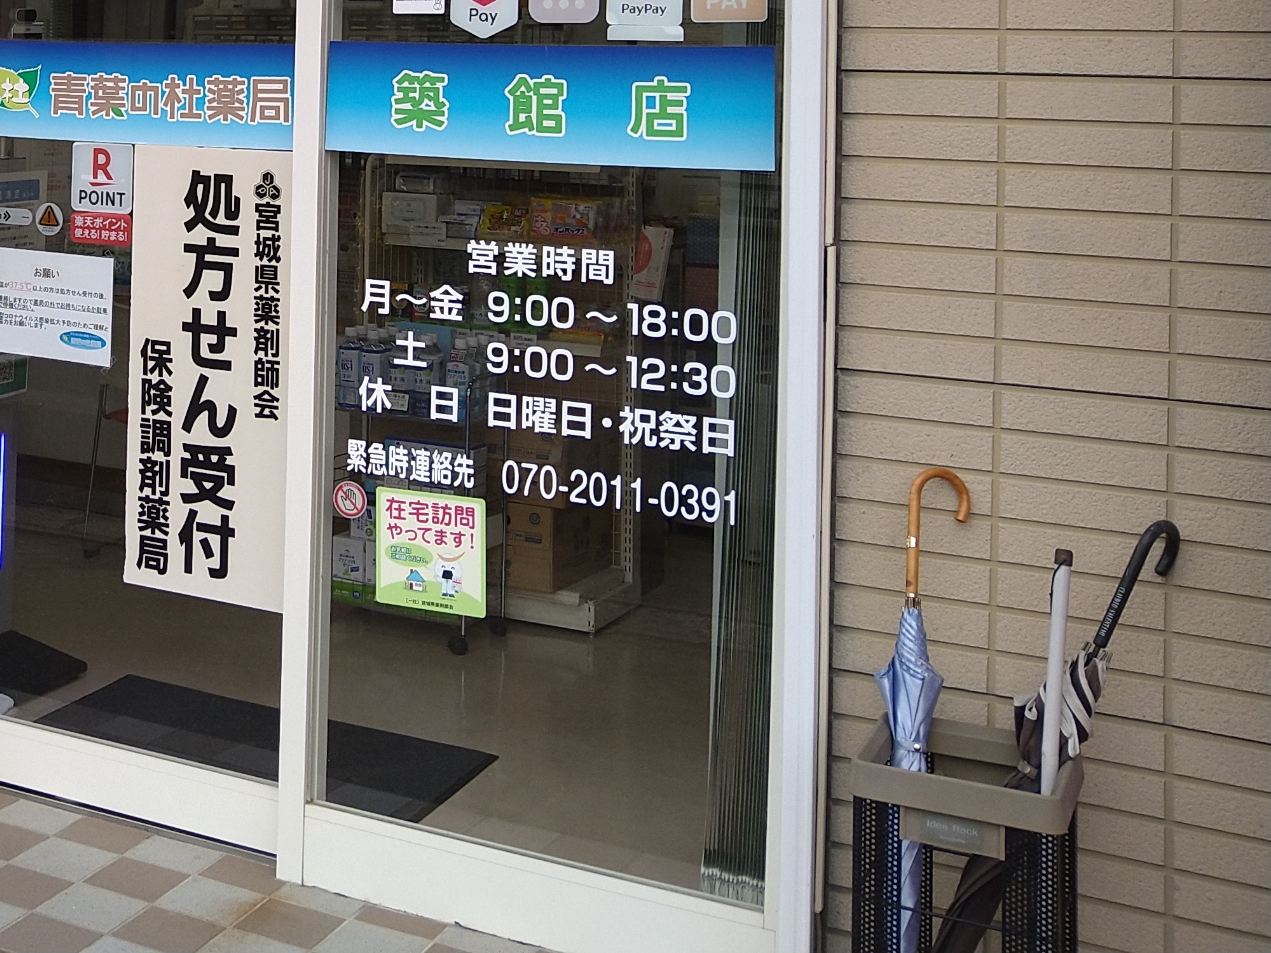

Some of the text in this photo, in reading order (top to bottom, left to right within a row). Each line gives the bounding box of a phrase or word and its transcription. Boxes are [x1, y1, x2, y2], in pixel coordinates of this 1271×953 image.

[469, 8, 498, 26] Pay
[621, 4, 667, 16] PayPay
[1, 77, 30, 103] 杜
[50, 73, 292, 126] 青葉の杜薬局
[391, 69, 691, 141] 築館店
[92, 148, 114, 180] R
[79, 190, 126, 207] POINT
[75, 216, 128, 230] 楽天ポイント
[33, 267, 60, 278] お願い
[466, 239, 616, 284] 営業時間
[253, 201, 282, 421] 宮城県薬剤師会
[360, 279, 464, 323] 月～金
[393, 331, 428, 370] 土
[178, 170, 240, 579] 処方せん受付
[487, 391, 736, 457] 日曜日・祝祭日
[136, 338, 173, 575] 保険調剤薬局
[346, 439, 737, 527] 緊急時連絡先 070-2011-0391
[385, 497, 475, 530] 在宅訪問
[387, 522, 474, 549] やってます！
